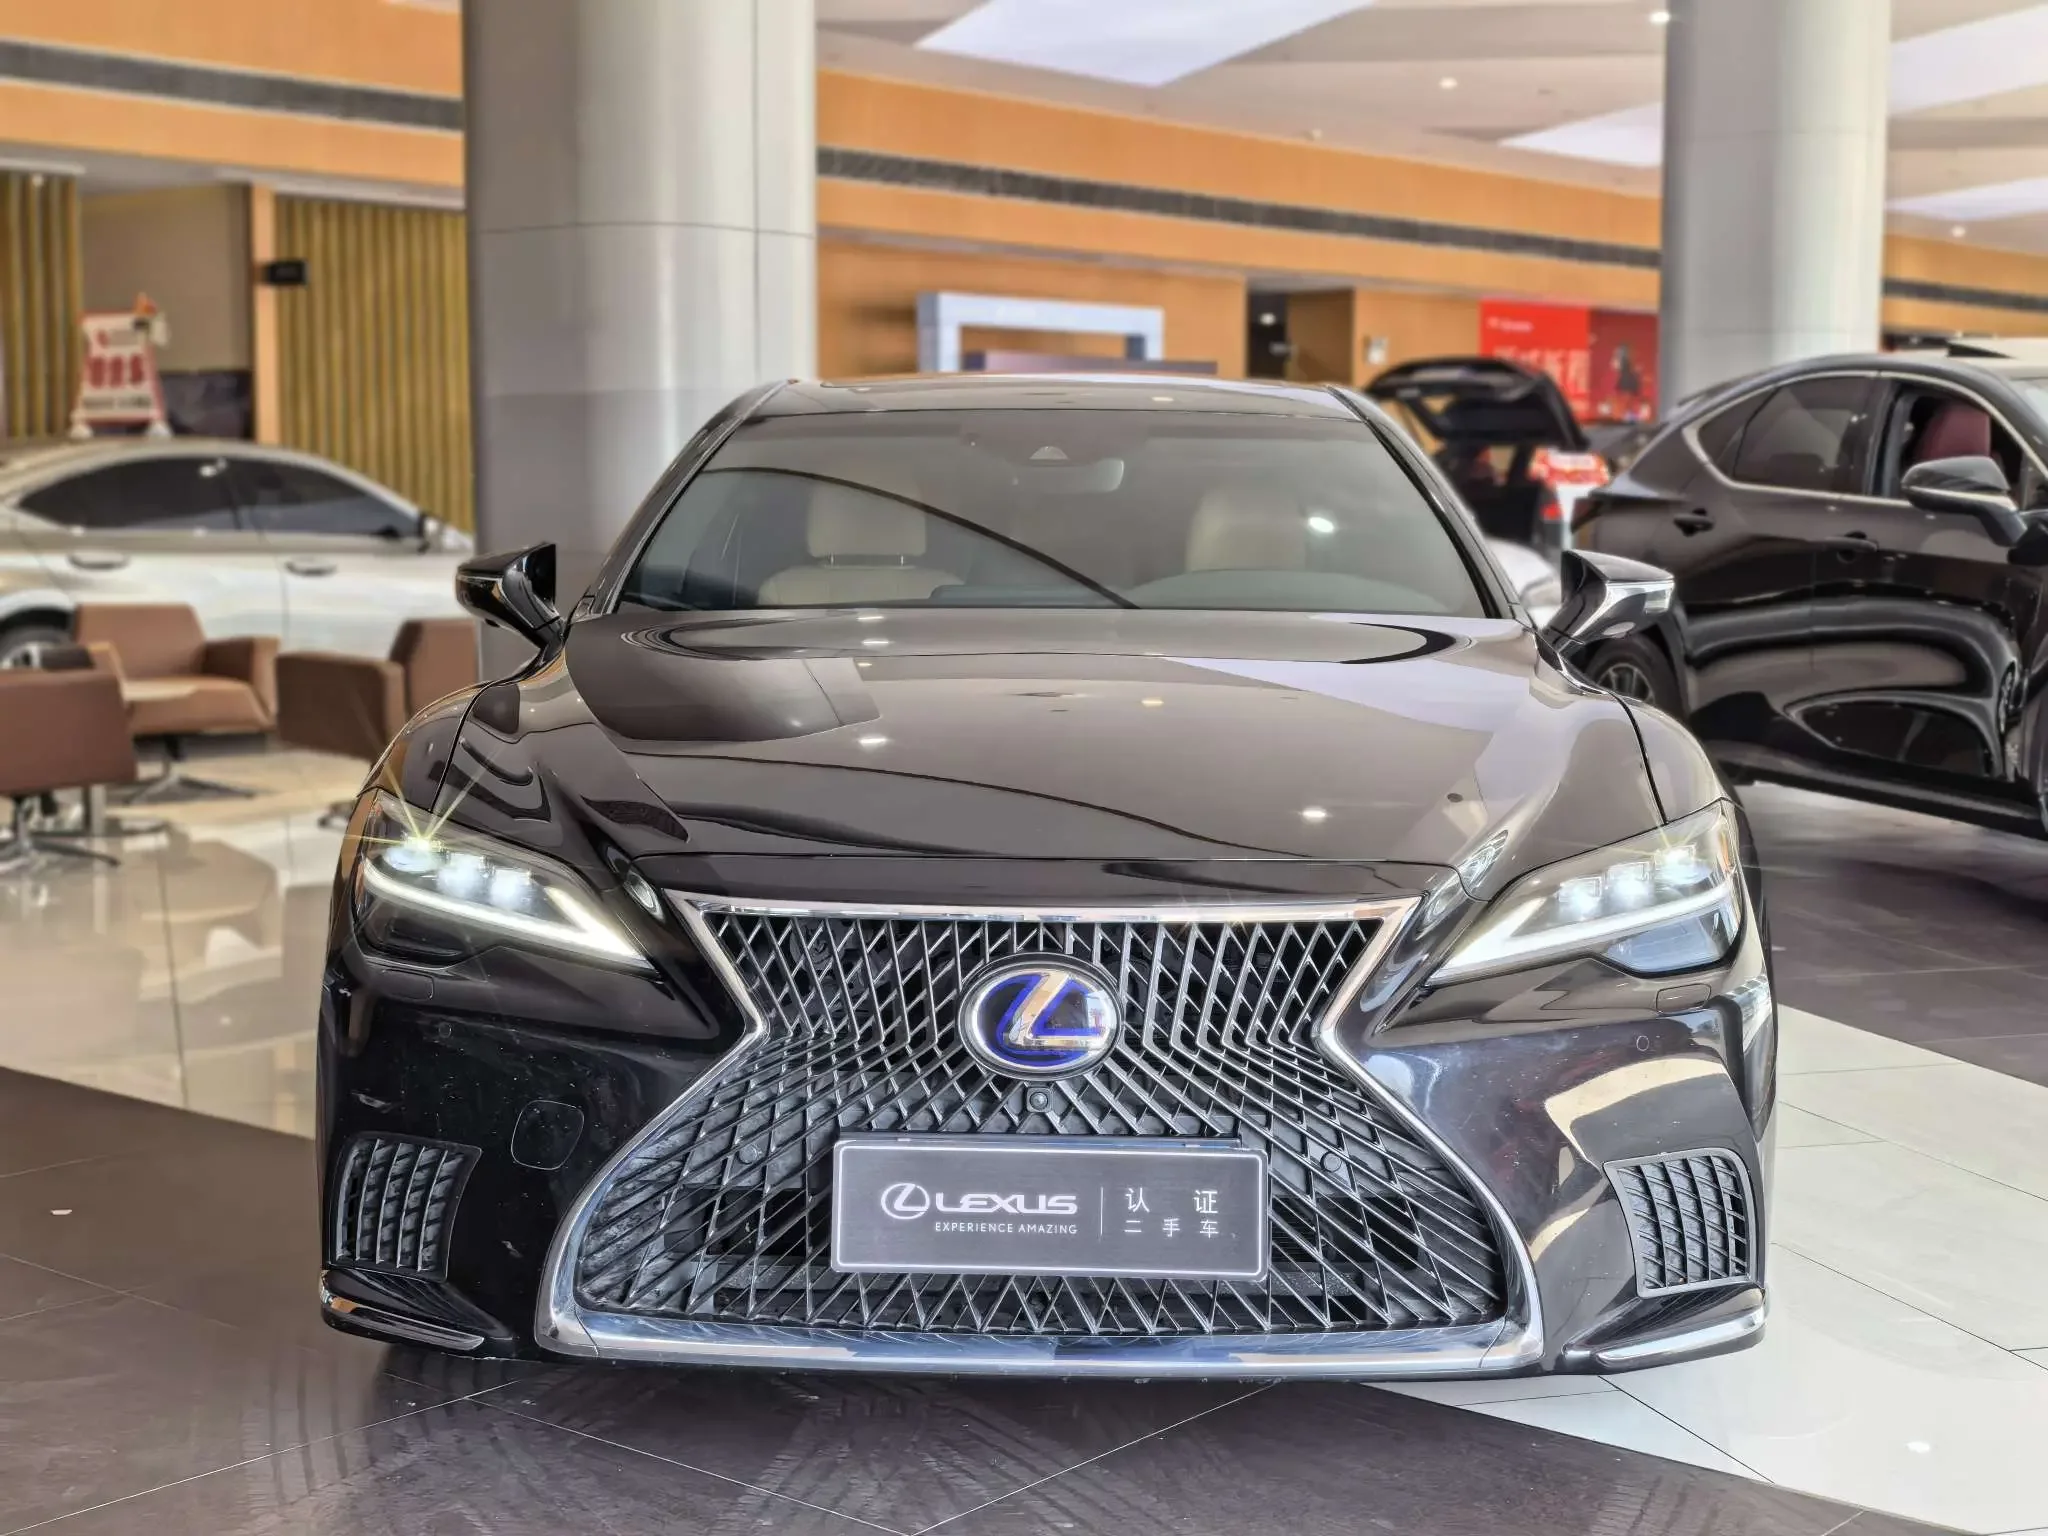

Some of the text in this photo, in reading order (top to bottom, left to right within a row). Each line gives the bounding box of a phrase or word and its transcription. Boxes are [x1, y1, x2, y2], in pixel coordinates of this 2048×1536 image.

[935, 1192, 1078, 1215] LEXUS
[935, 1221, 1078, 1235] EXPERIENCE AMAZING
[1123, 1217, 1220, 1239] 二手车
